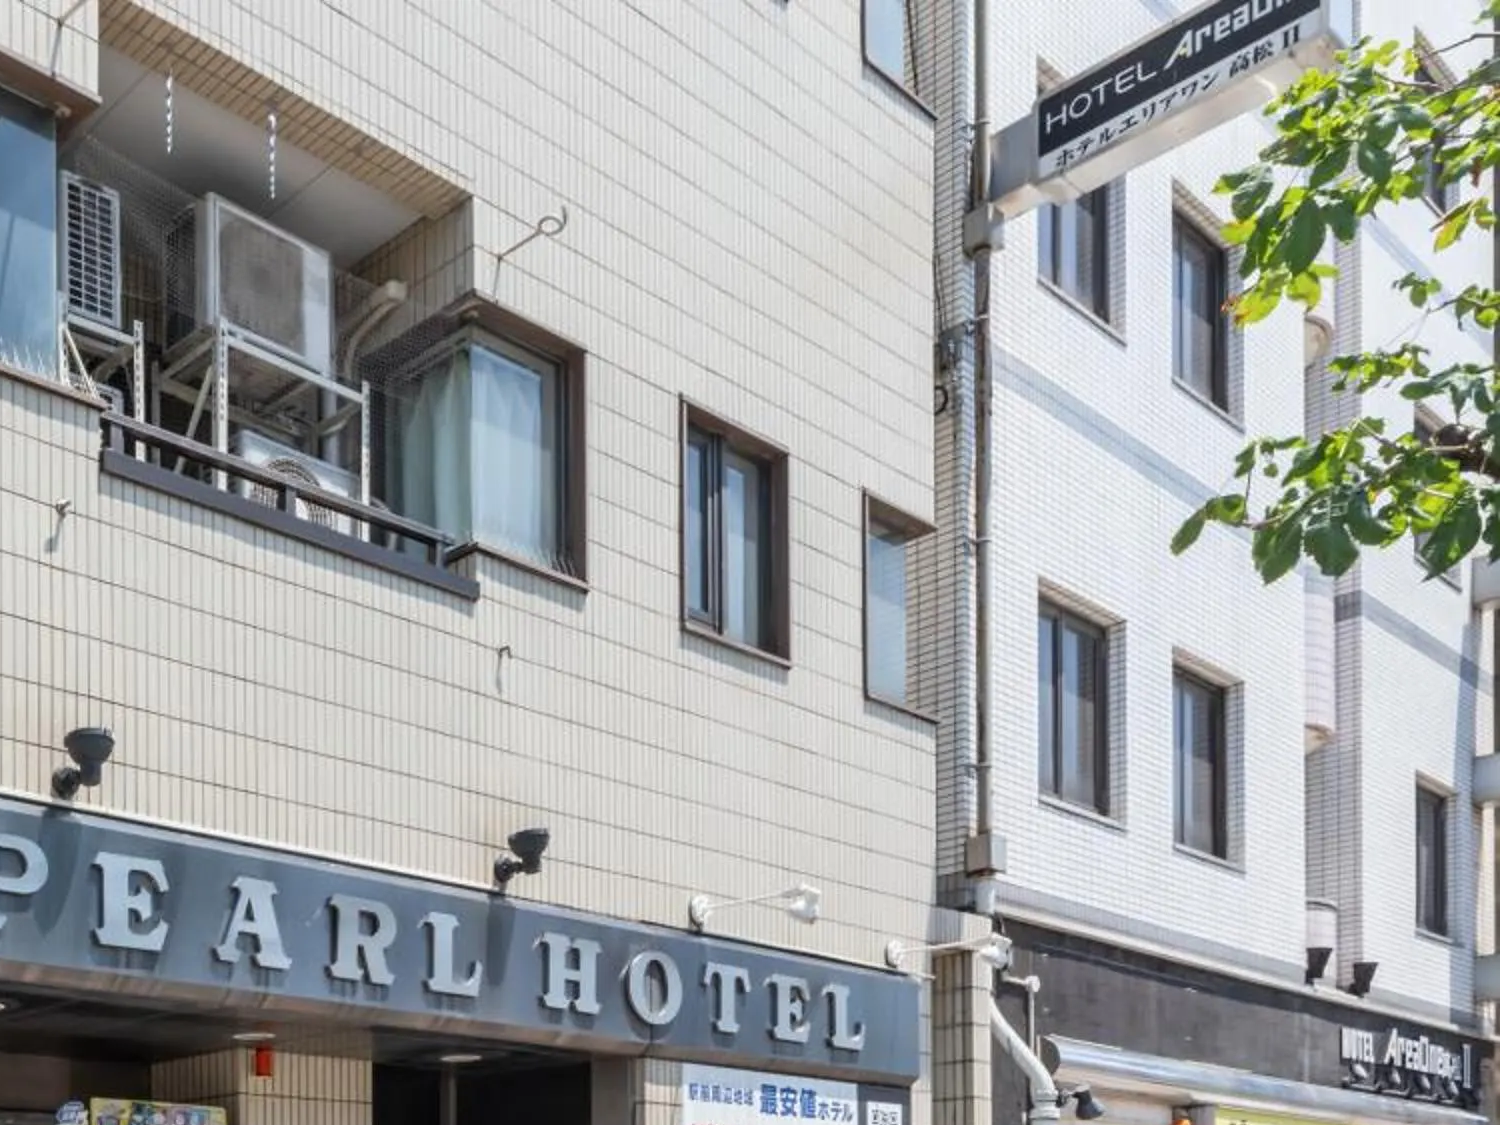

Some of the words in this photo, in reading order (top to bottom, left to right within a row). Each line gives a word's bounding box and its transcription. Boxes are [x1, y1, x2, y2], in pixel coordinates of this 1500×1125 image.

[1045, 61, 1157, 135] HOTEL
[1163, 0, 1292, 71] AreaO
[1055, 71, 1220, 168] ホテルエリアワン
[536, 932, 866, 1052] HOTEL
